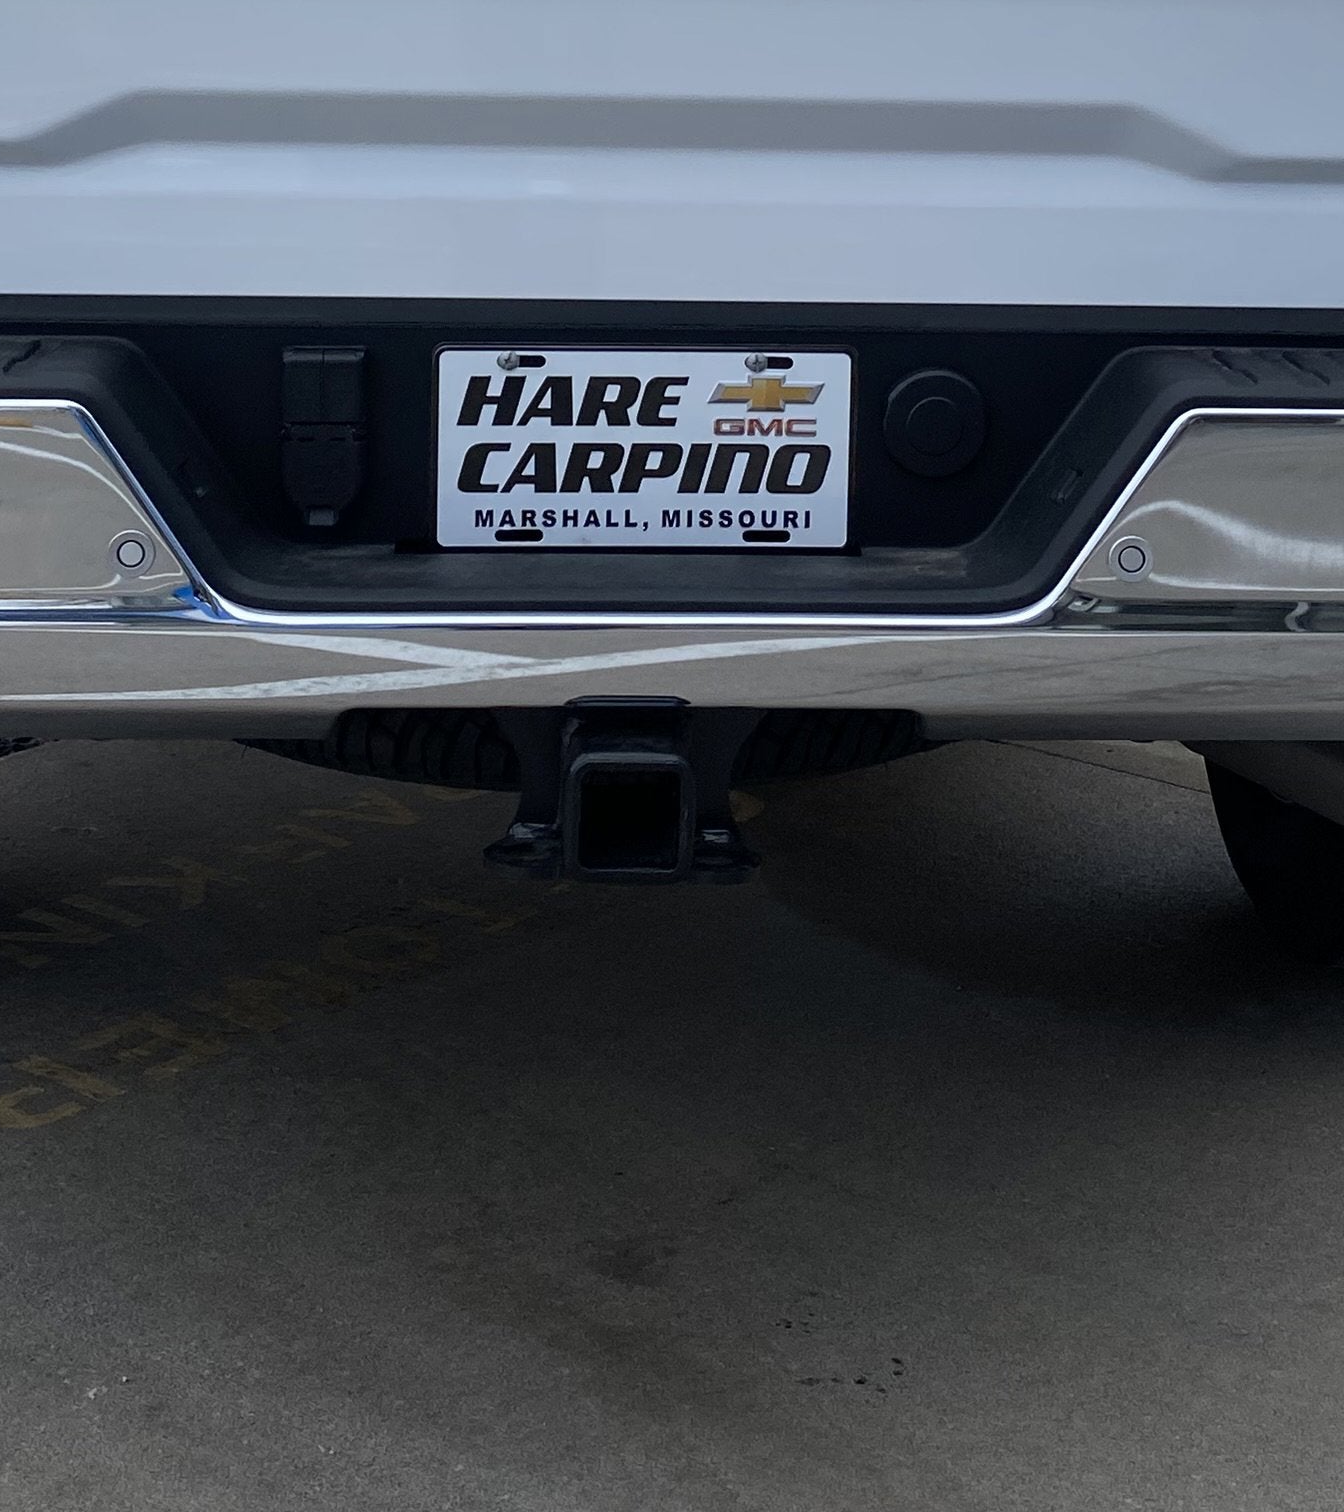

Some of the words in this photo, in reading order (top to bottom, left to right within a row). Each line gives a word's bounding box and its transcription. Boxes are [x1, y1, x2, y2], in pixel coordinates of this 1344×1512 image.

[456, 374, 691, 428] HARE
[712, 418, 818, 438] GMC
[456, 441, 832, 495] CARPINO
[474, 508, 650, 533] MARSHALL,
[661, 508, 812, 530] MISSOURI
